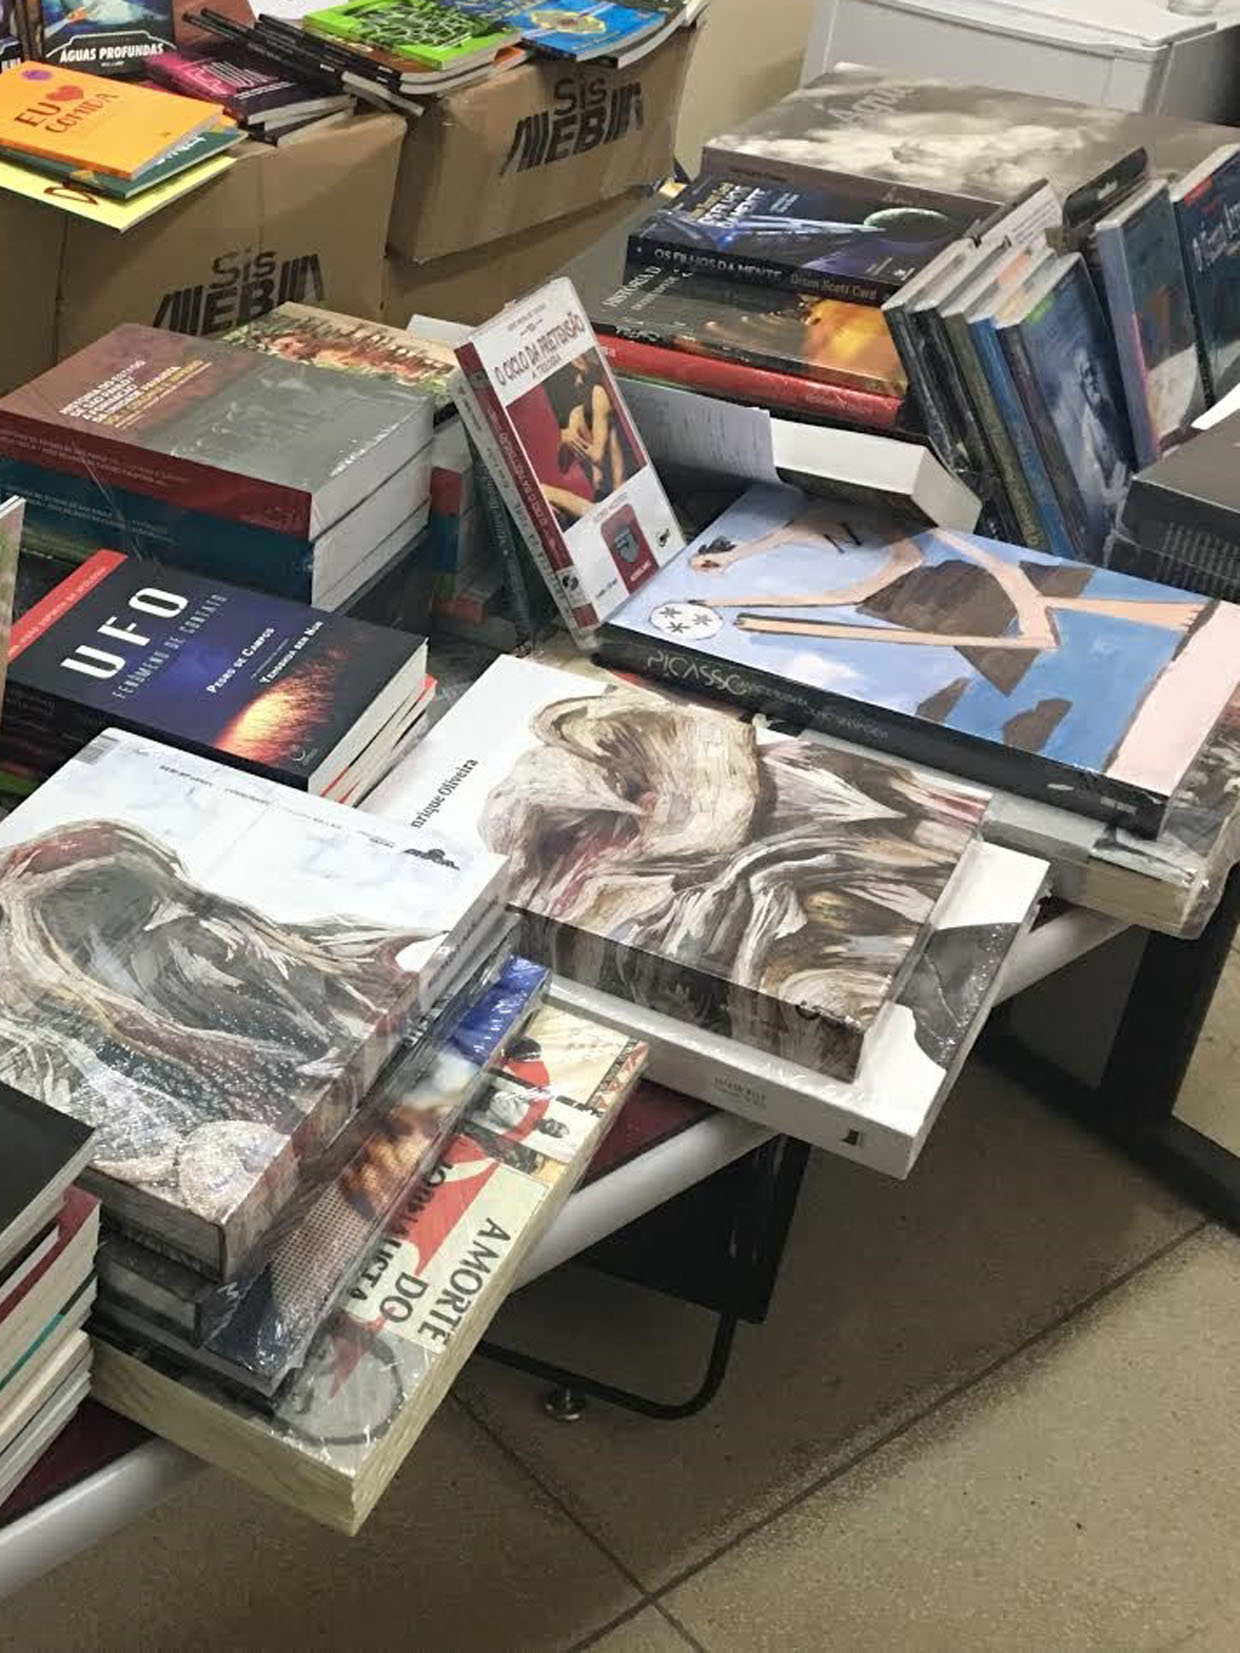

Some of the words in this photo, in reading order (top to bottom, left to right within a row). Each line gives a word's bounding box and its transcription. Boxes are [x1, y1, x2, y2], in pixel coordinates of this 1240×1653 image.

[60, 44, 97, 63] ÁGUAS
[99, 43, 164, 60] PROFUNDAS
[14, 102, 61, 127] EU
[45, 93, 119, 133] COMIDA
[60, 586, 188, 680] UFO
[647, 650, 748, 697] PICASSO
[438, 759, 479, 796] Oliveira
[379, 1271, 430, 1324] DO
